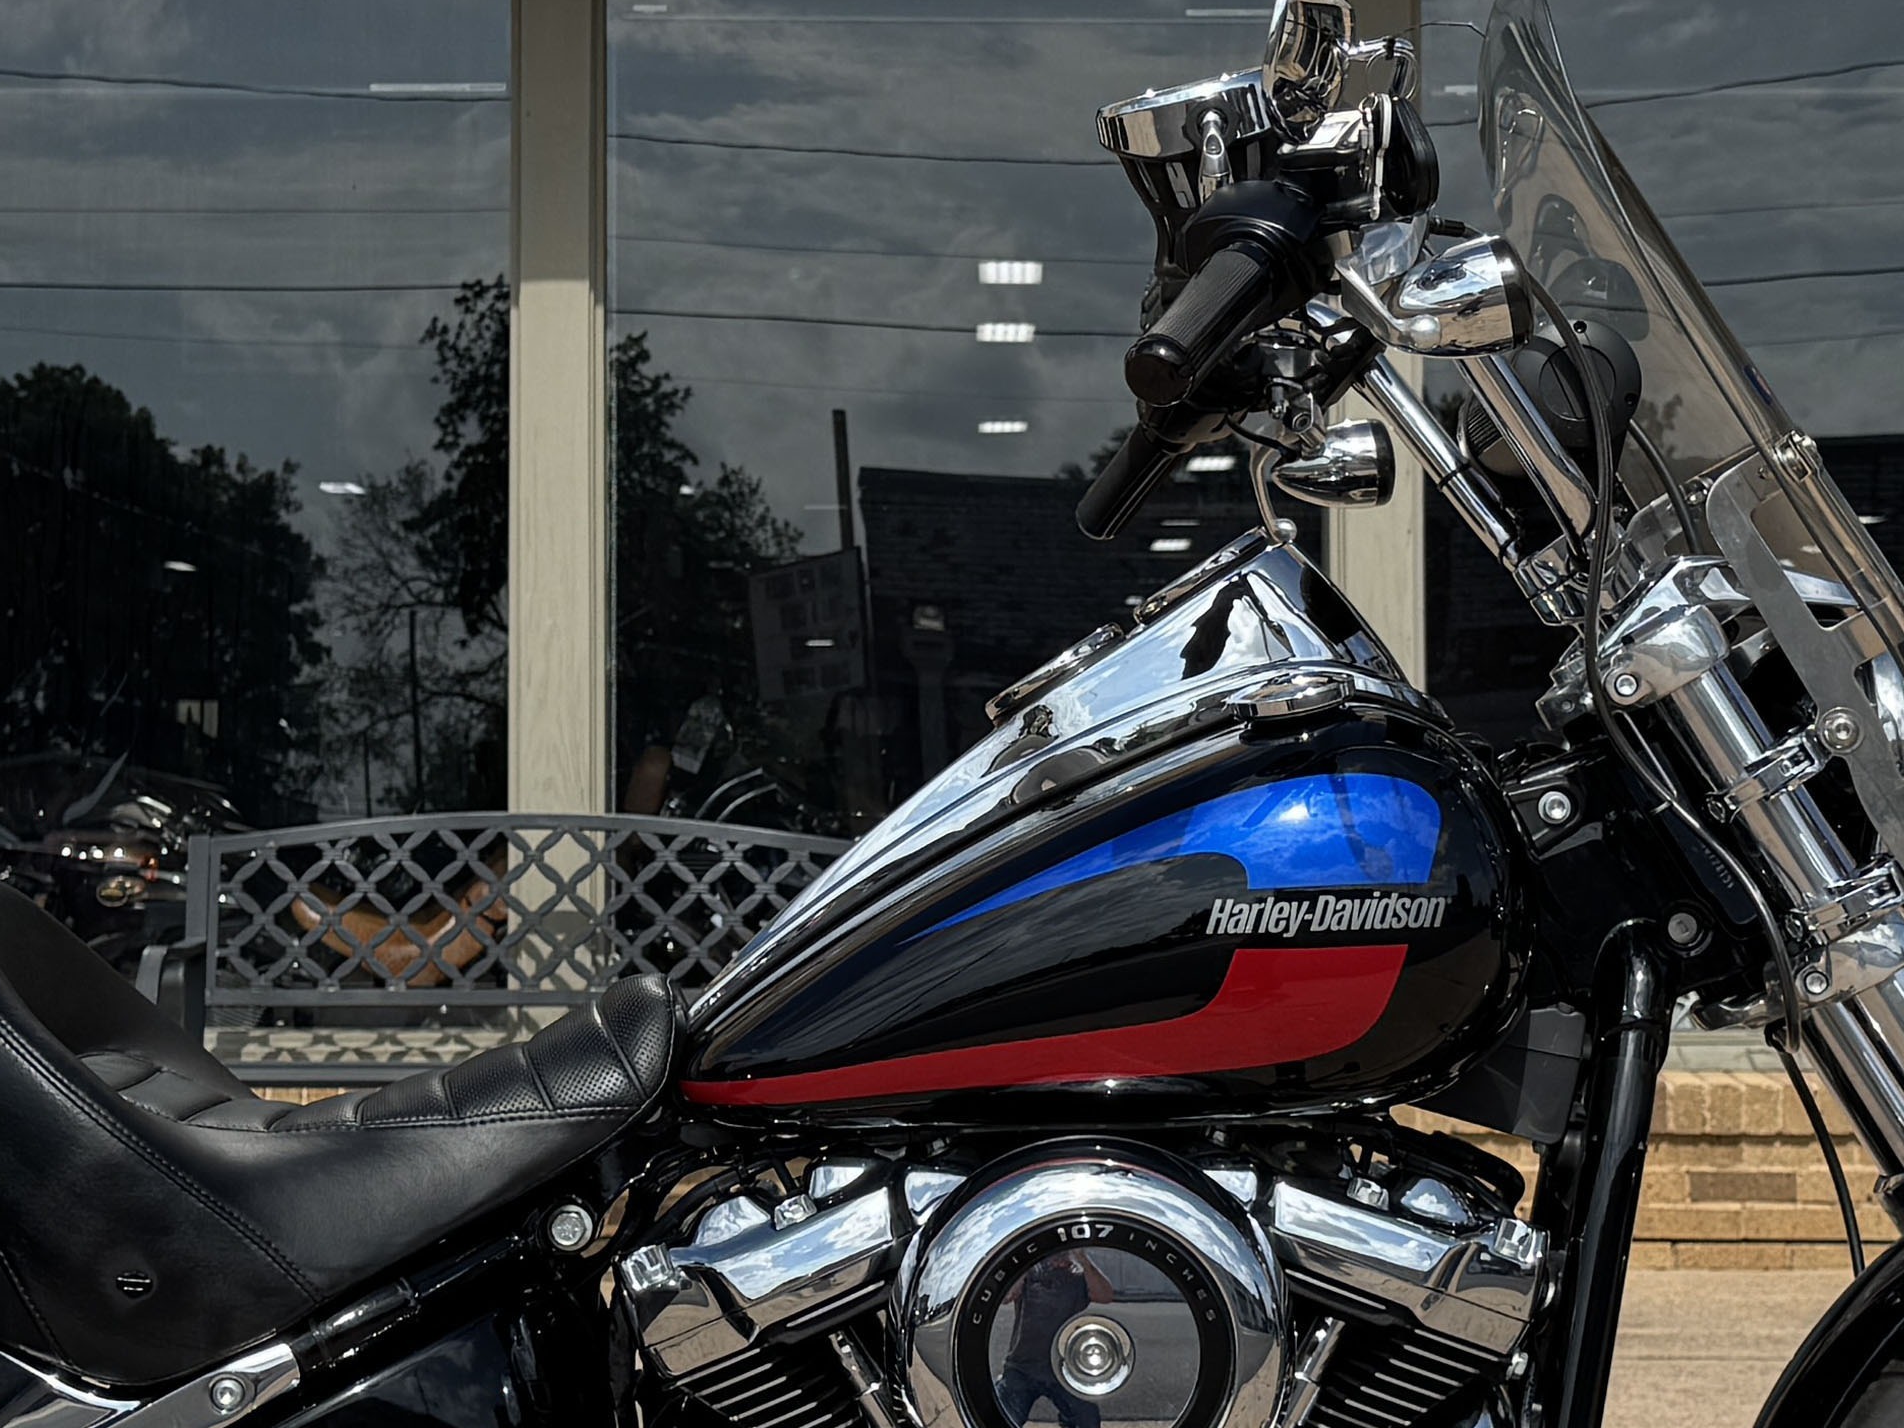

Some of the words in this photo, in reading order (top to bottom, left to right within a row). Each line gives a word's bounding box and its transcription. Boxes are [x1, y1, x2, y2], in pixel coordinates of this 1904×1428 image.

[1206, 891, 1446, 938] Harley-Davidson
[971, 1243, 1038, 1326] CUBIC
[1056, 1222, 1115, 1243] 107
[1128, 1231, 1217, 1324] INCHES
